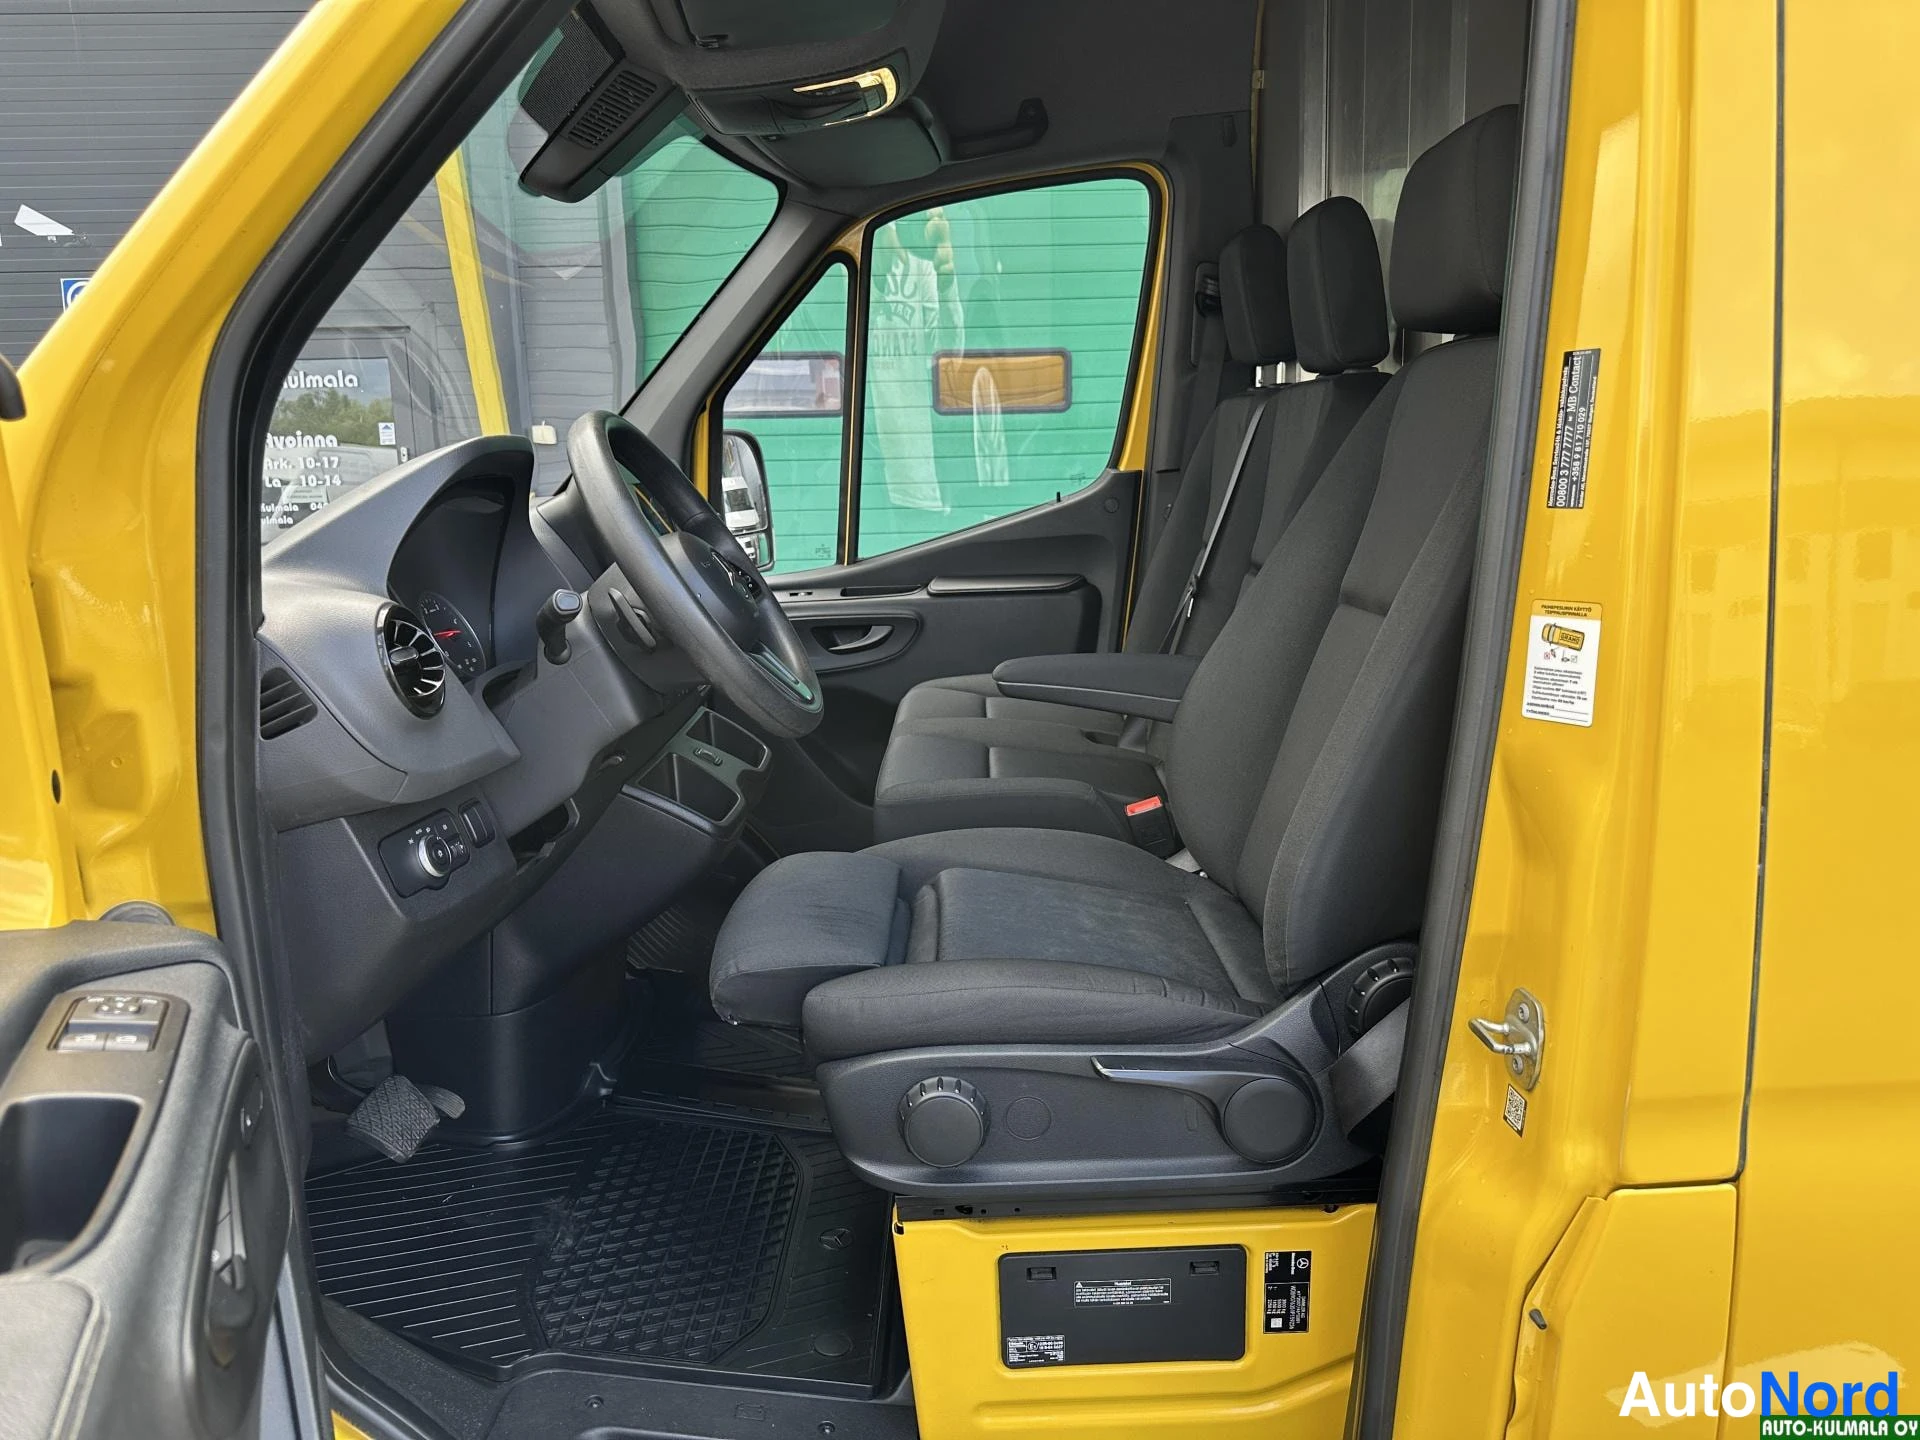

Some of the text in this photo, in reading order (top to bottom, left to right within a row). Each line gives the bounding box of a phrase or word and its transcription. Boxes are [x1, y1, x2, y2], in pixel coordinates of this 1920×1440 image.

[1568, 356, 1582, 395] Contact
[1566, 396, 1577, 413] MB
[1577, 407, 1586, 423] 029
[1562, 425, 1574, 449] 7777
[1575, 425, 1584, 440] 710
[1573, 442, 1582, 452] 81
[298, 456, 339, 469] 10-17
[1560, 451, 1571, 468] 777
[1570, 461, 1580, 482] +358
[265, 474, 342, 488] La 10-14
[1555, 478, 1568, 507] 00800
